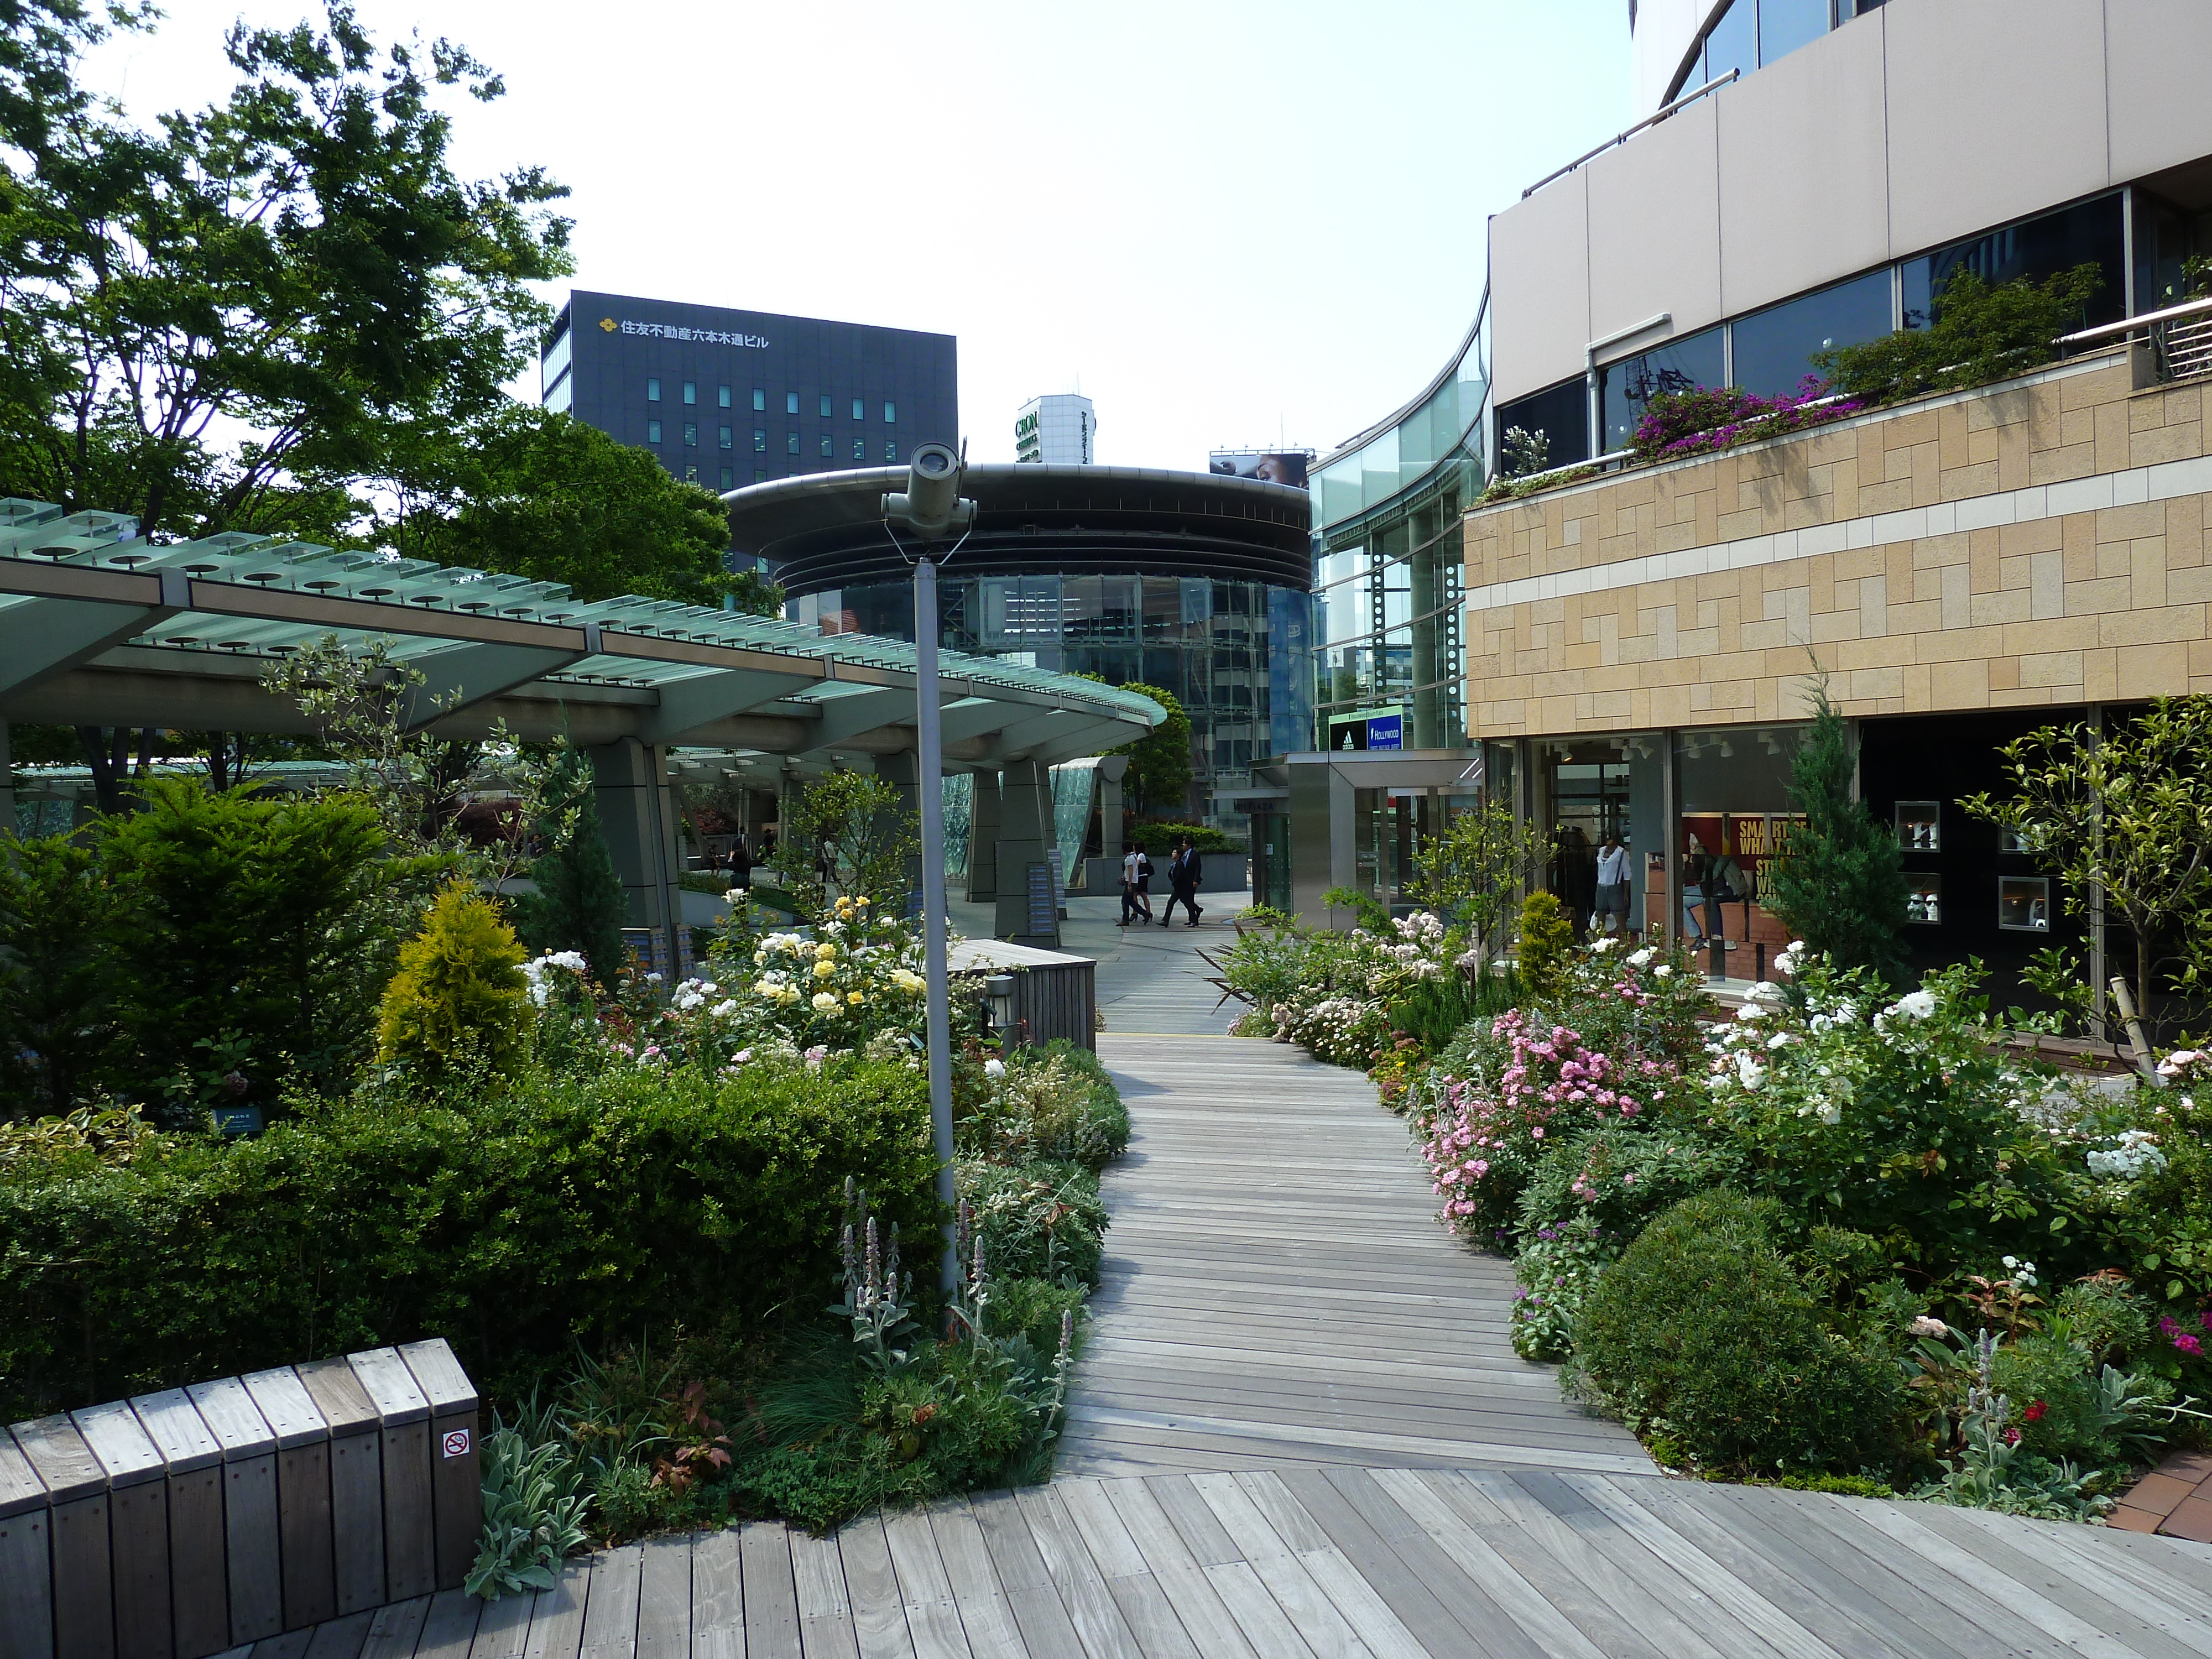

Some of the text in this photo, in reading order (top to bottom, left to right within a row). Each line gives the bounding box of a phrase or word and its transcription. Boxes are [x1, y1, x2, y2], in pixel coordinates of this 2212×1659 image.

[621, 320, 769, 348] 住友不動産六本木通ビル
[1375, 729, 1399, 740] HOLLYWOOD
[1739, 821, 1788, 838] SMART
[1739, 838, 1782, 855] WHAT
